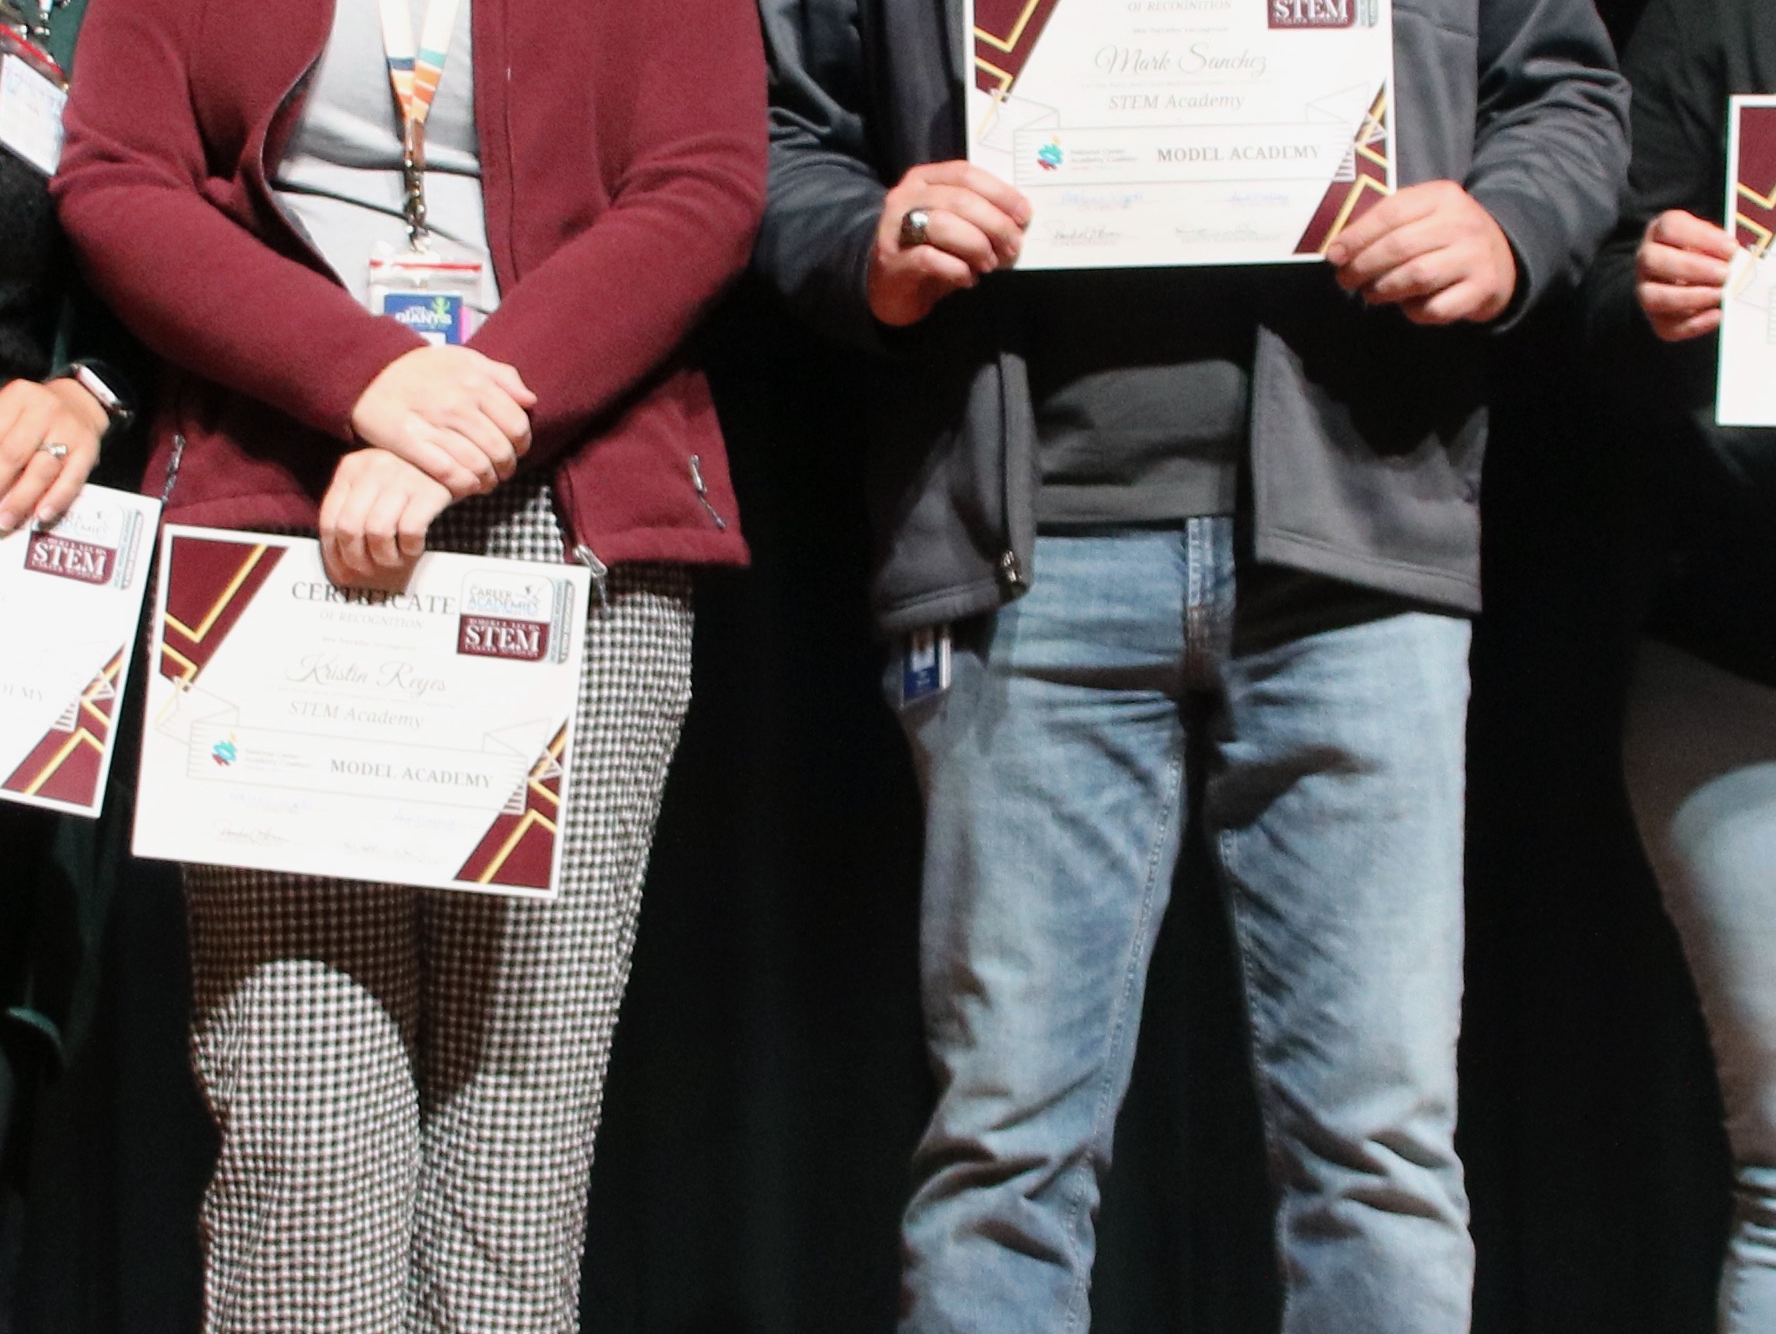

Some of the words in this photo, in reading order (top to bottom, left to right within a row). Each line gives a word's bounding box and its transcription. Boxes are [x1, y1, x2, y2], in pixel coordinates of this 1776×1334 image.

[1094, 44, 1171, 75] Mark
[1178, 41, 1267, 79] Sanchez
[1108, 94, 1158, 110] STEM
[1165, 92, 1245, 111] Academy
[1157, 147, 1223, 162] MODEL
[1230, 145, 1320, 160] ACADEMY
[32, 541, 106, 578] STEM
[319, 608, 334, 621] OF
[335, 610, 423, 630] RECOGNITION
[464, 624, 539, 652] STEM
[284, 649, 369, 689] Kristin
[375, 658, 448, 700] Reyes
[288, 700, 338, 719] STEM
[343, 704, 424, 730] Academy
[329, 758, 395, 779] MODEL
[401, 766, 493, 789] ACADEMY
